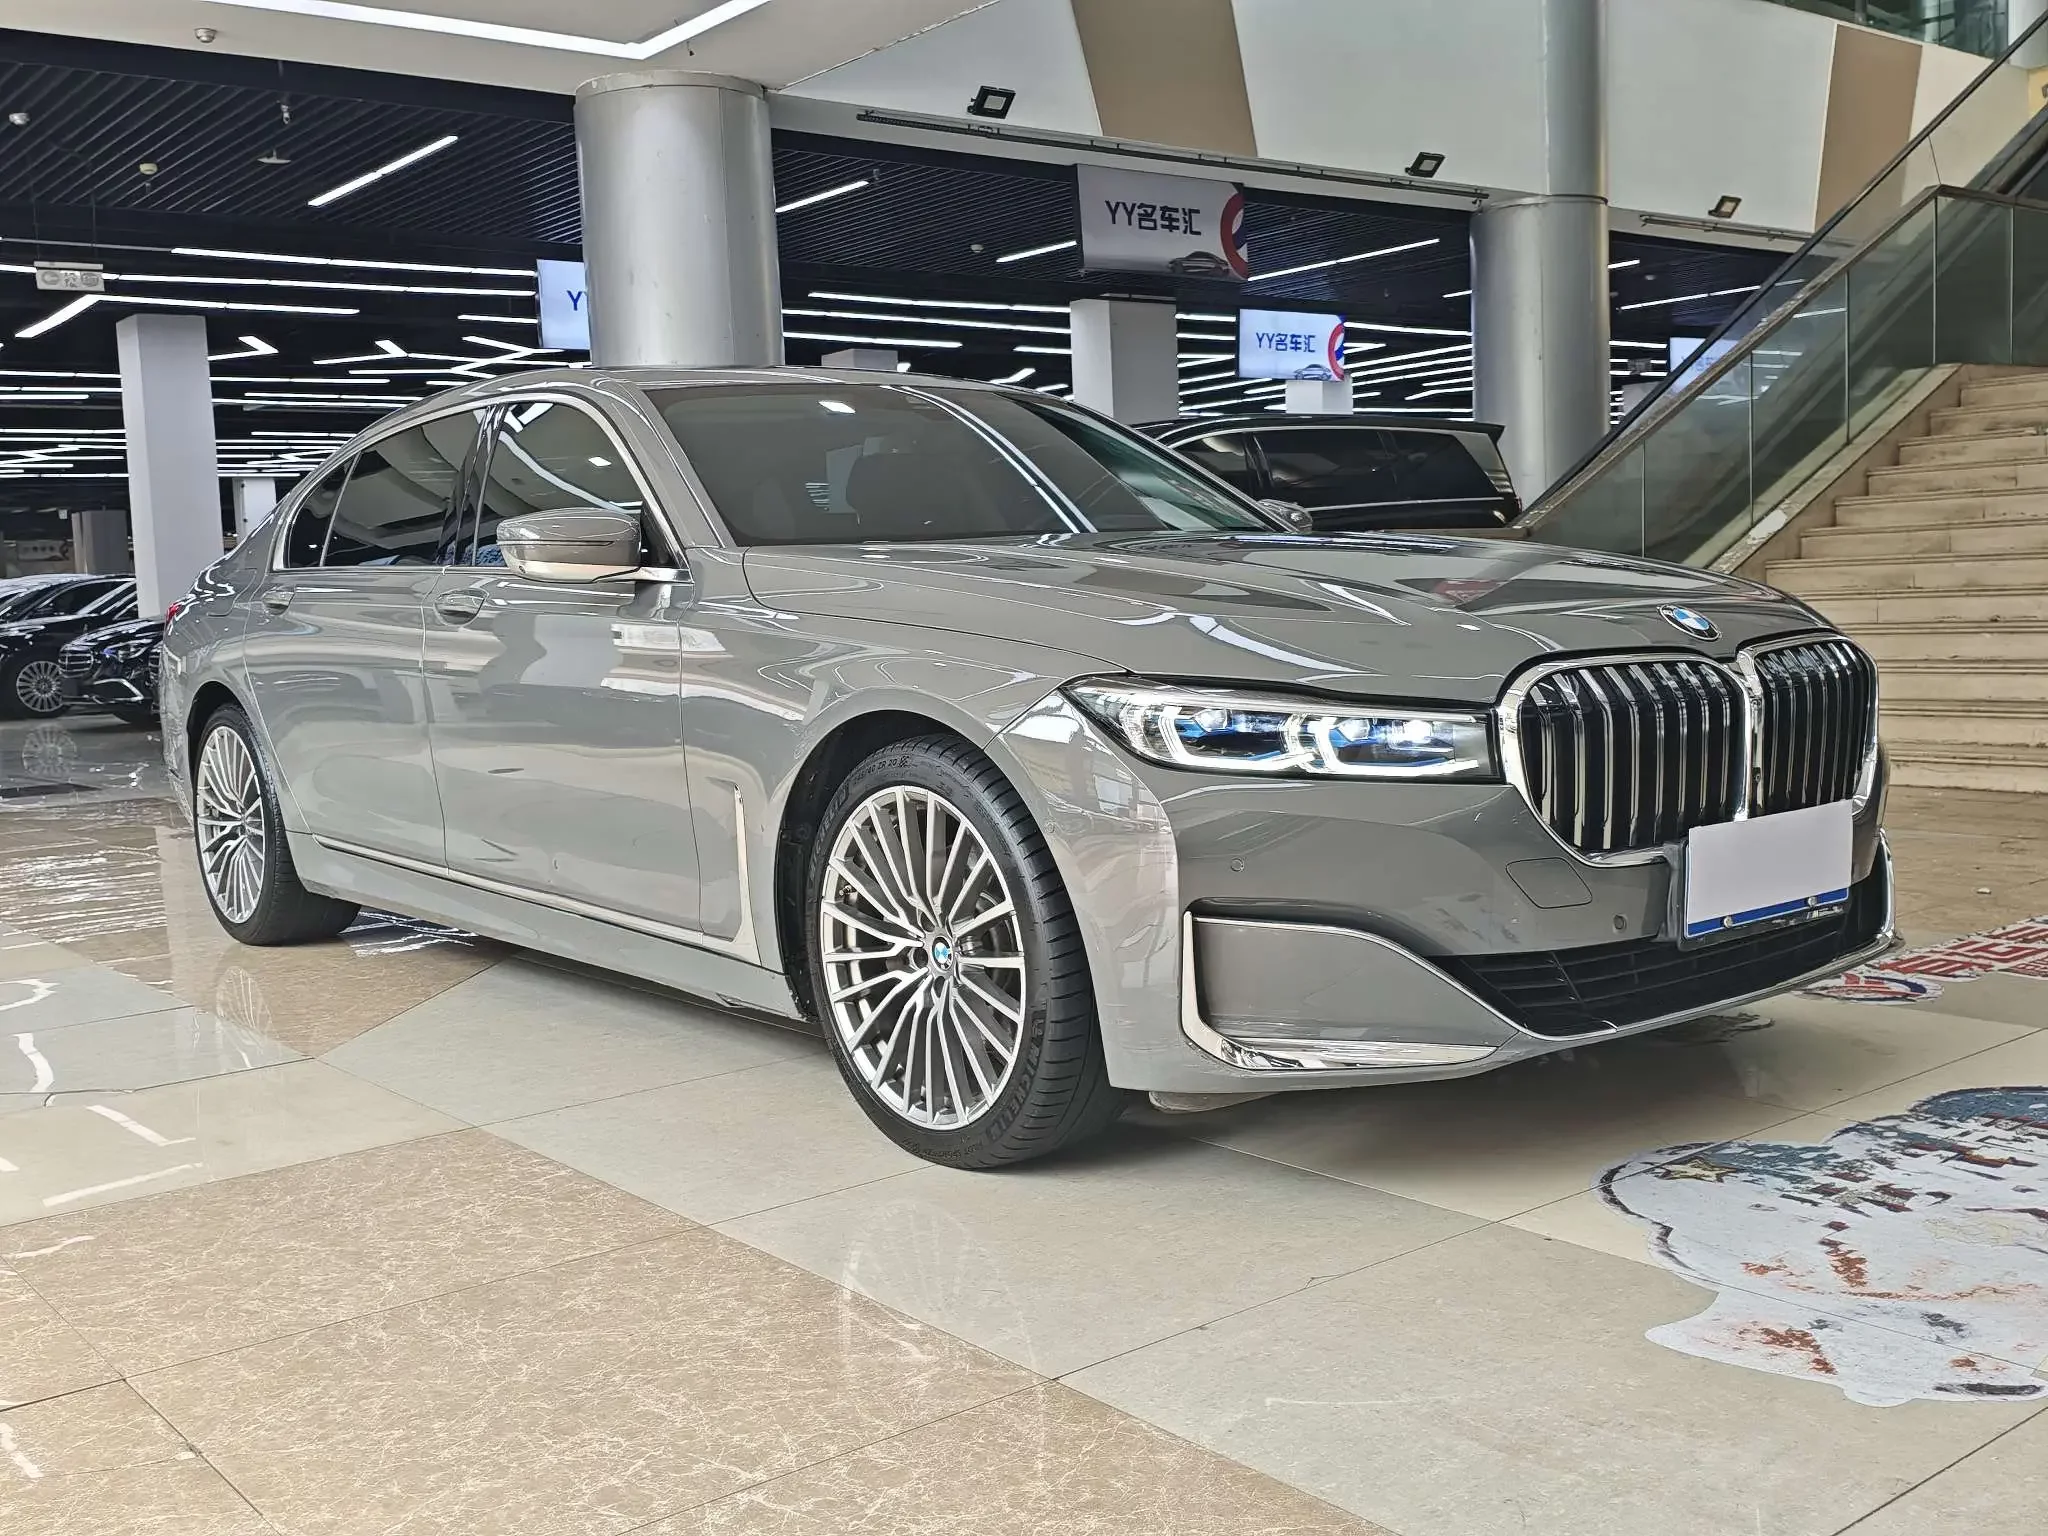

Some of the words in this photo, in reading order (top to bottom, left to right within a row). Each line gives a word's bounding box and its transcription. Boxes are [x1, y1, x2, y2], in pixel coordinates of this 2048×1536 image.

[1105, 200, 1202, 236] YY名车汇
[1256, 332, 1316, 353] YY名车汇
[986, 1042, 1040, 1140] MICHELIN
